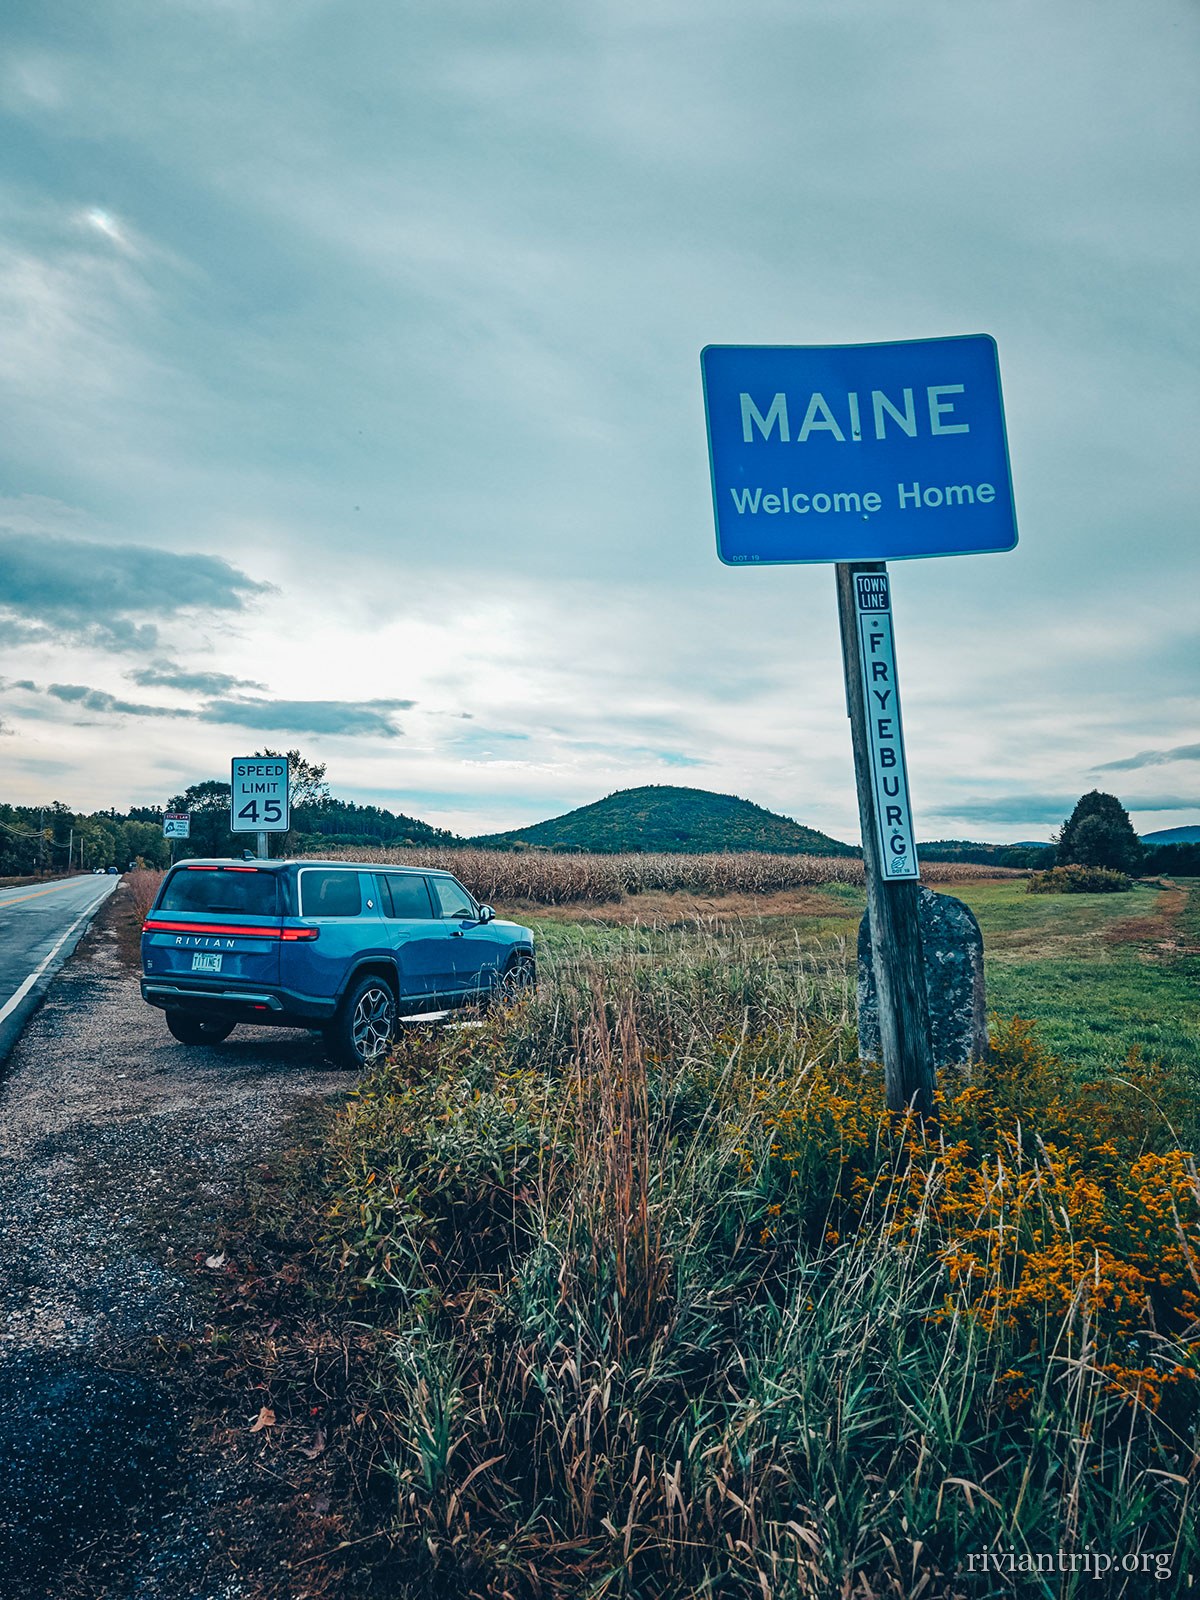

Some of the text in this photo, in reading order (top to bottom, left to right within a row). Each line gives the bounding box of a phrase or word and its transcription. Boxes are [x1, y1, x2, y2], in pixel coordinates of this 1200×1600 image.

[739, 384, 970, 442] MAINE
[730, 482, 996, 514] Welcome Home
[858, 578, 887, 592] TOWN
[861, 593, 885, 608] LINE
[870, 633, 906, 855] FRYEBURG
[237, 765, 284, 776] SPEED
[242, 783, 278, 793] LIMIT
[238, 800, 282, 823] 45
[175, 936, 235, 948] RIVIAN
